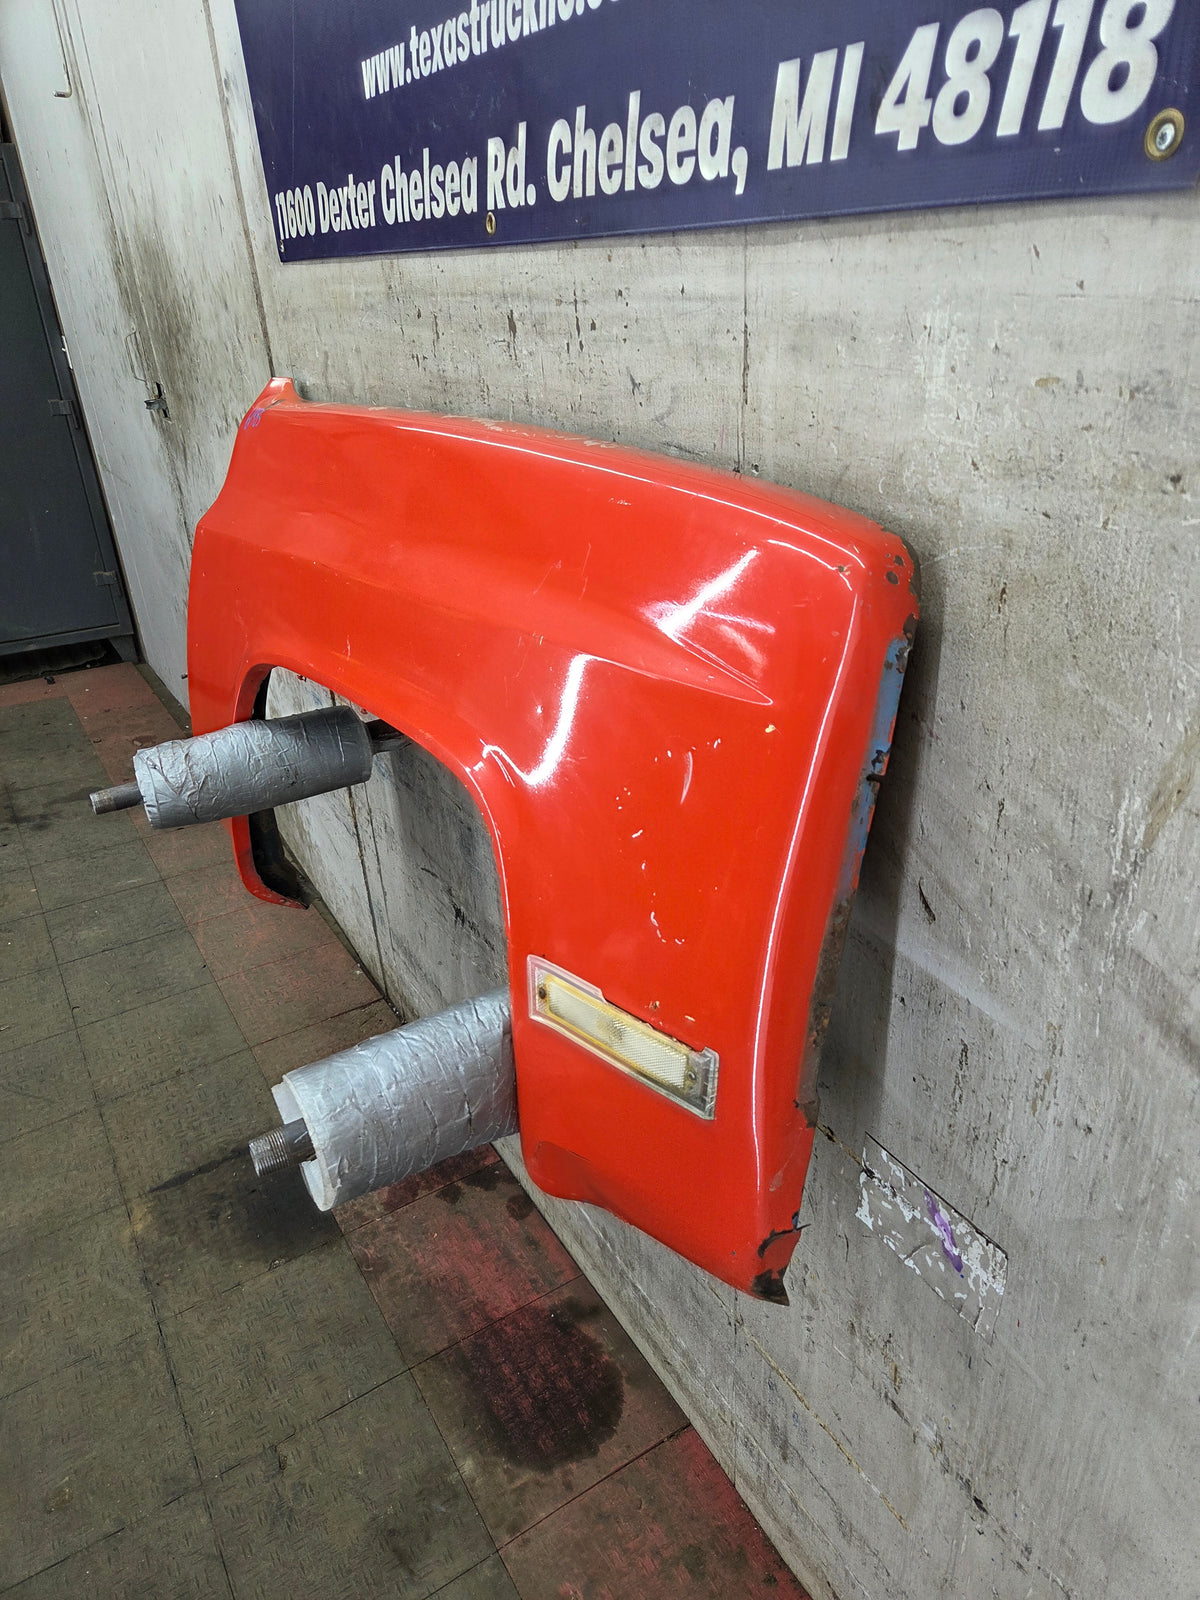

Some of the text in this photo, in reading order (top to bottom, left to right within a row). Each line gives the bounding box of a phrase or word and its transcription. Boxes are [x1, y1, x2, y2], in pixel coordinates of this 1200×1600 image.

[275, 0, 1176, 240] 11600 Dexter Chelsea Rd. Chelsea, MI 48118
[361, 0, 619, 100] www.texastruck.
